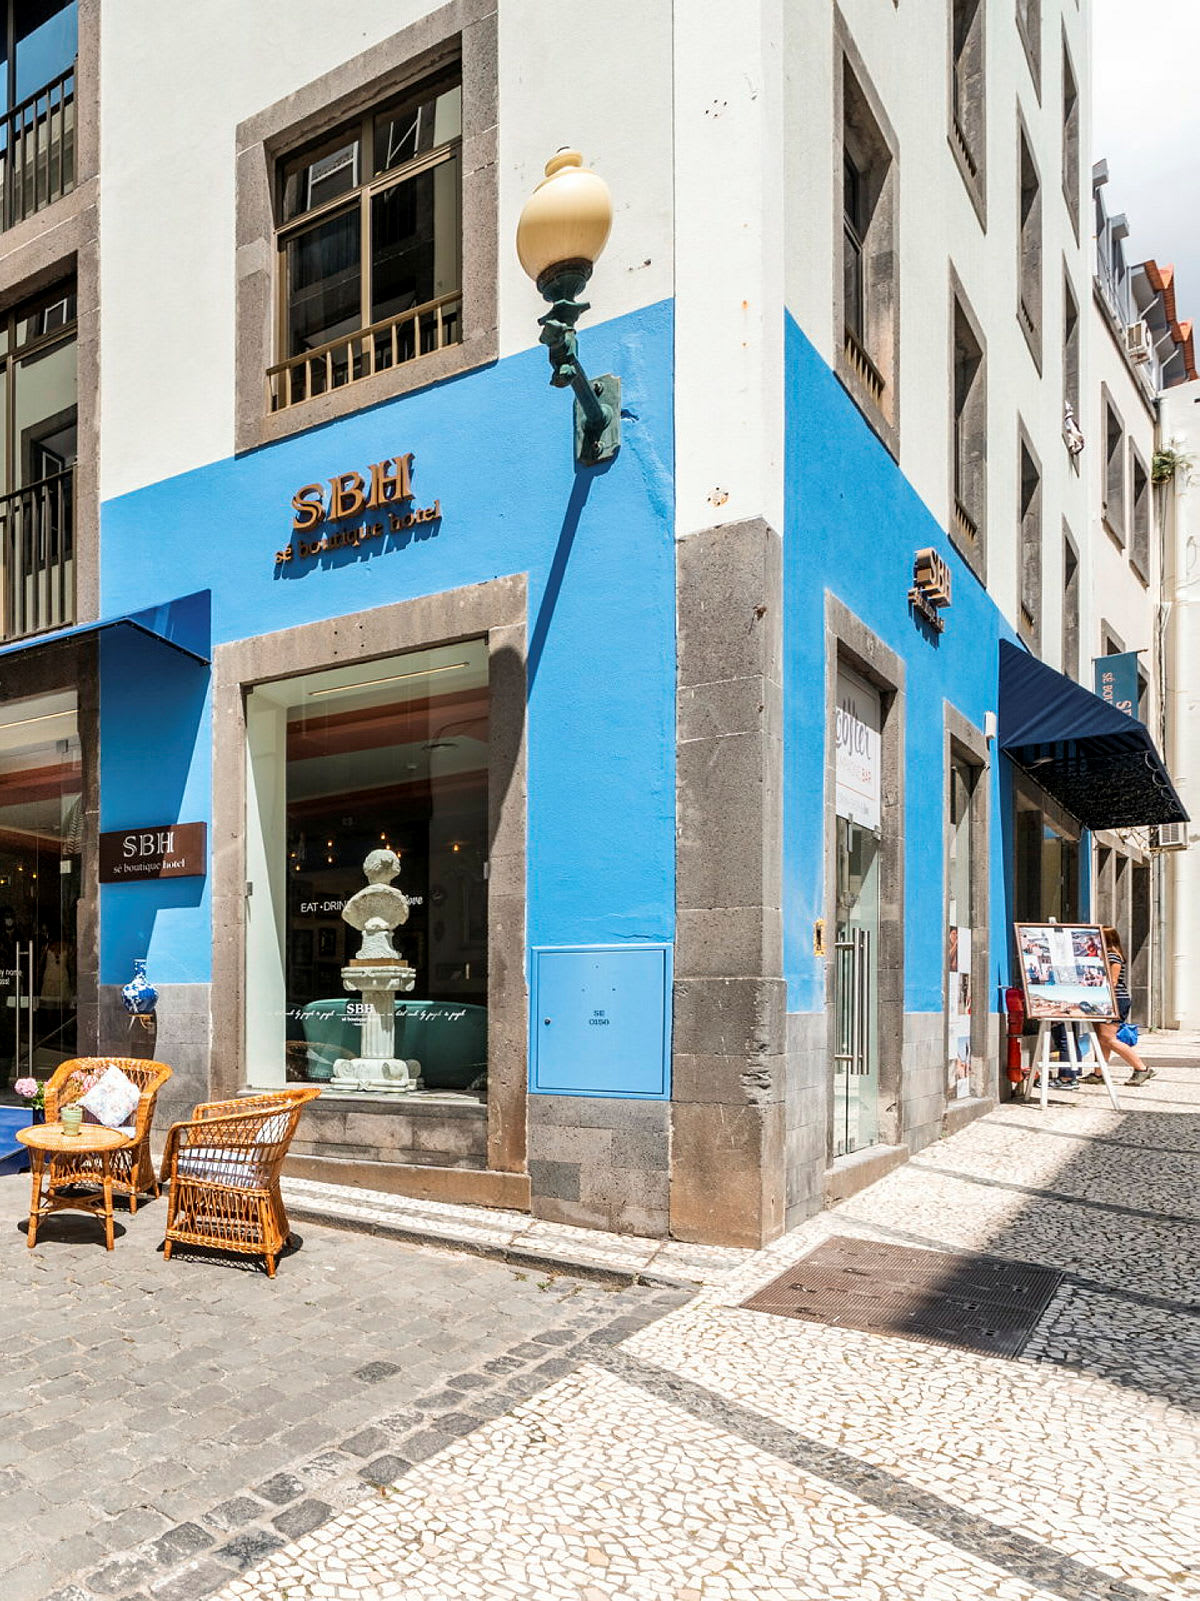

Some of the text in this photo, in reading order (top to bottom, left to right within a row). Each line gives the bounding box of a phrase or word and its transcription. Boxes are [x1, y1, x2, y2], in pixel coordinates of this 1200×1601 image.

[291, 452, 416, 532] SBH
[388, 499, 442, 532] hotel
[123, 831, 175, 858] SBH
[123, 861, 161, 873] boutique
[162, 858, 186, 869] hotel
